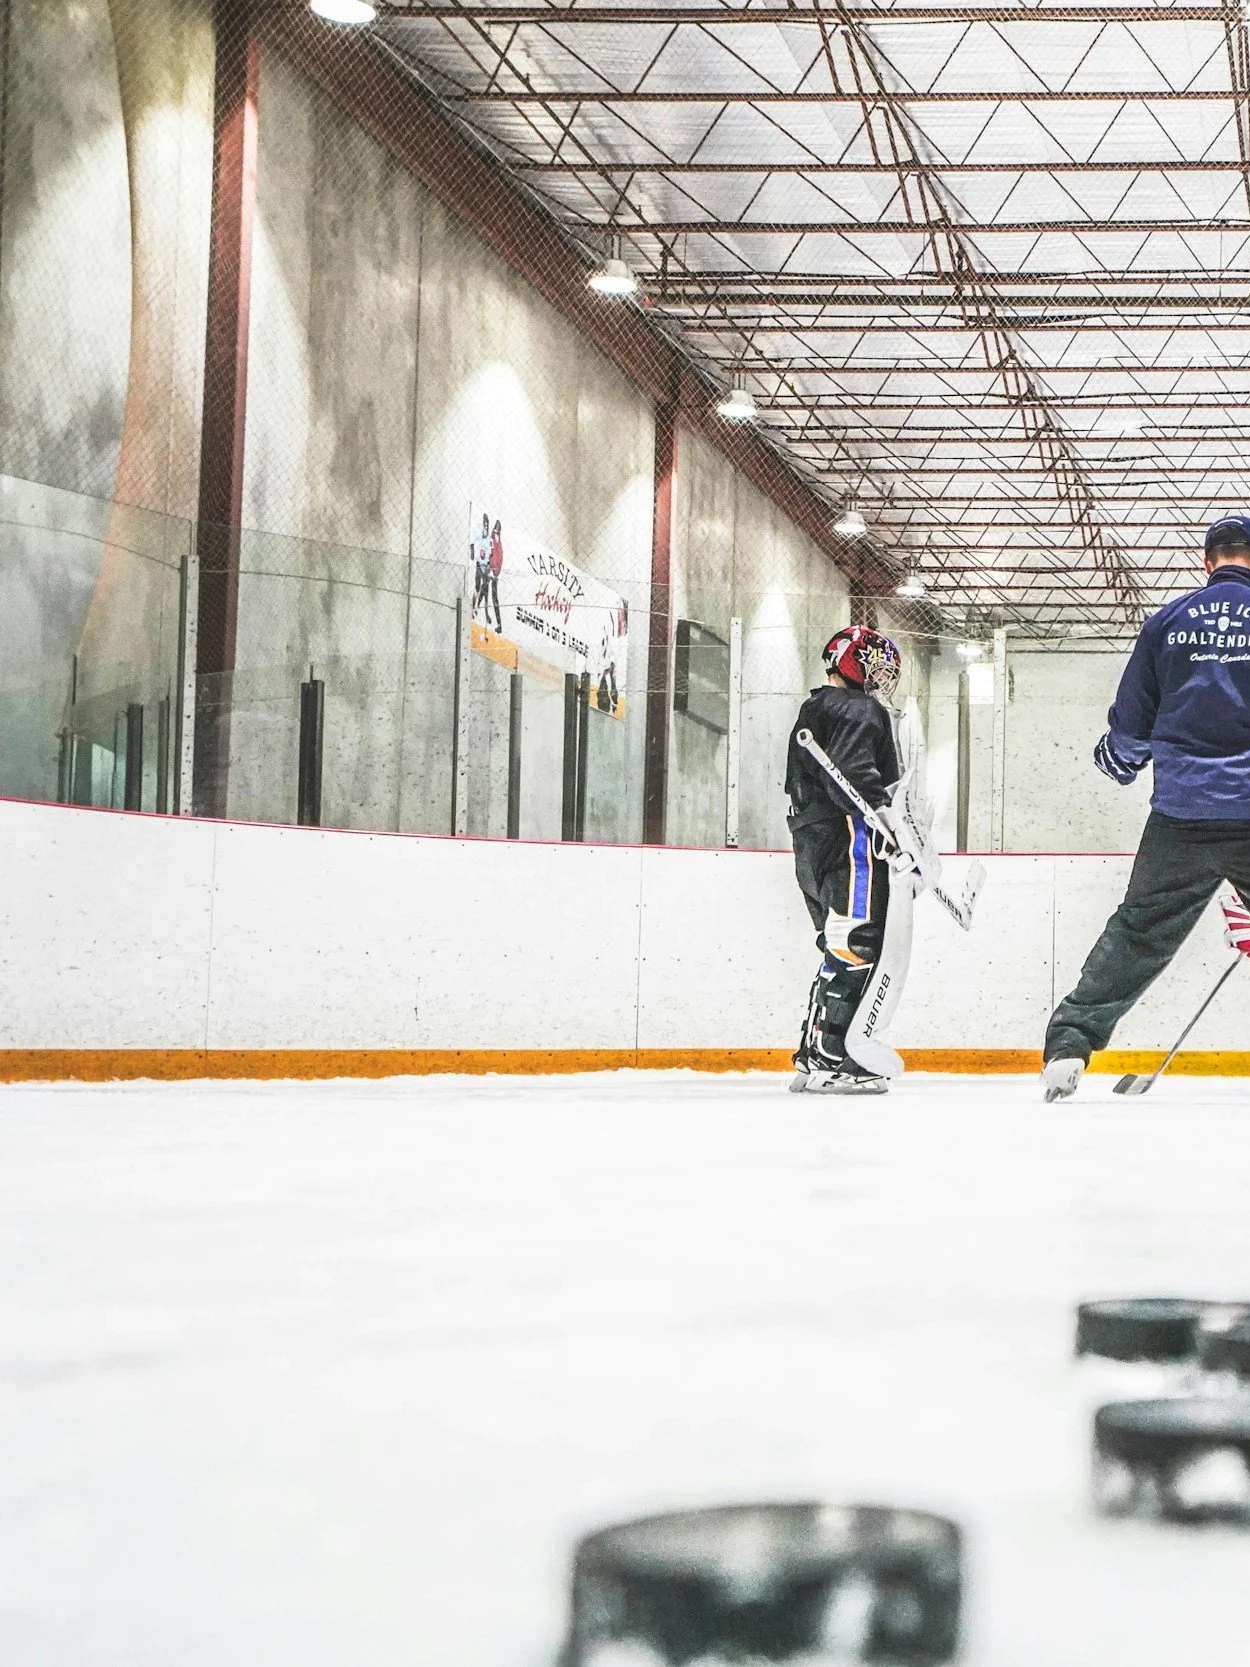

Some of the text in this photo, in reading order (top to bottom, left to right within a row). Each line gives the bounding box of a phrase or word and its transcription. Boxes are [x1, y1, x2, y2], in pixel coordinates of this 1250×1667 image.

[526, 554, 585, 599] VARSITY
[1188, 601, 1230, 618] BLUE
[1190, 653, 1250, 664] Ontario Canada
[863, 973, 891, 1038] BAUER
